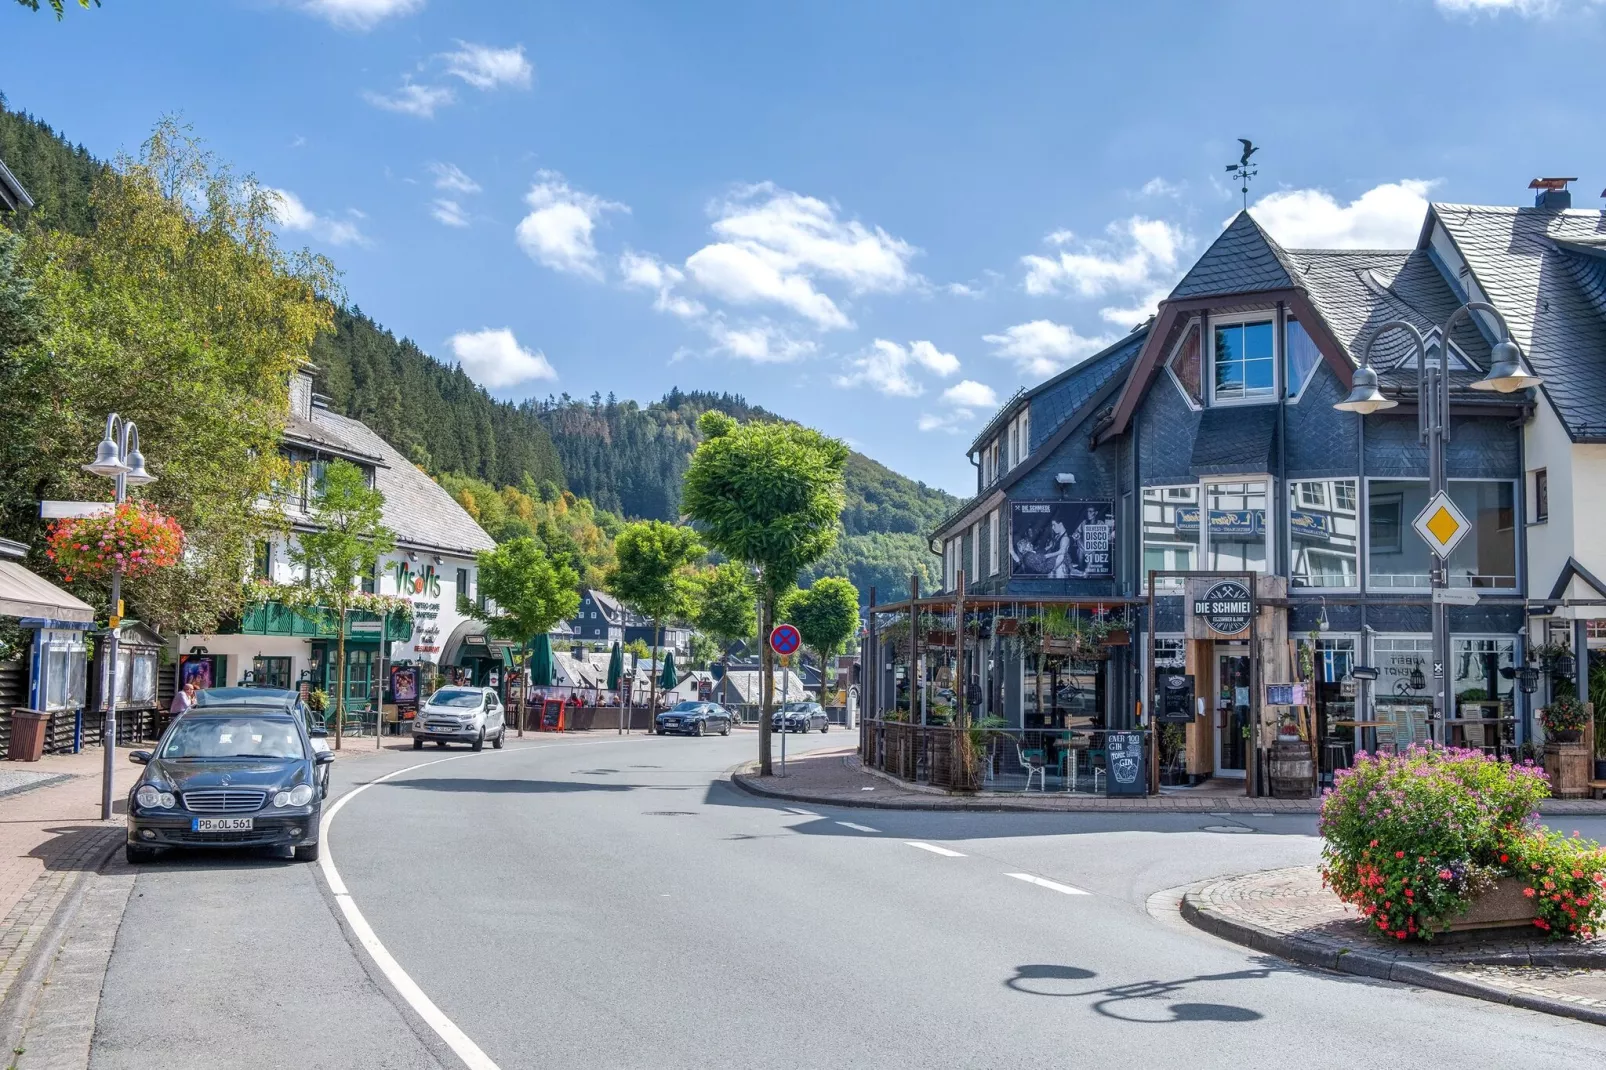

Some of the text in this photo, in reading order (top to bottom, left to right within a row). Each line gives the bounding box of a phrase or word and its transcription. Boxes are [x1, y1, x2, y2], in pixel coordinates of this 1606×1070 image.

[1086, 532, 1106, 540] DISCO
[1086, 541, 1106, 549] DISCO
[1085, 553, 1108, 562] 31 DEZ
[1196, 602, 1210, 613] DIE
[1119, 758, 1133, 767] GIN
[199, 819, 251, 829] PB OL 561
